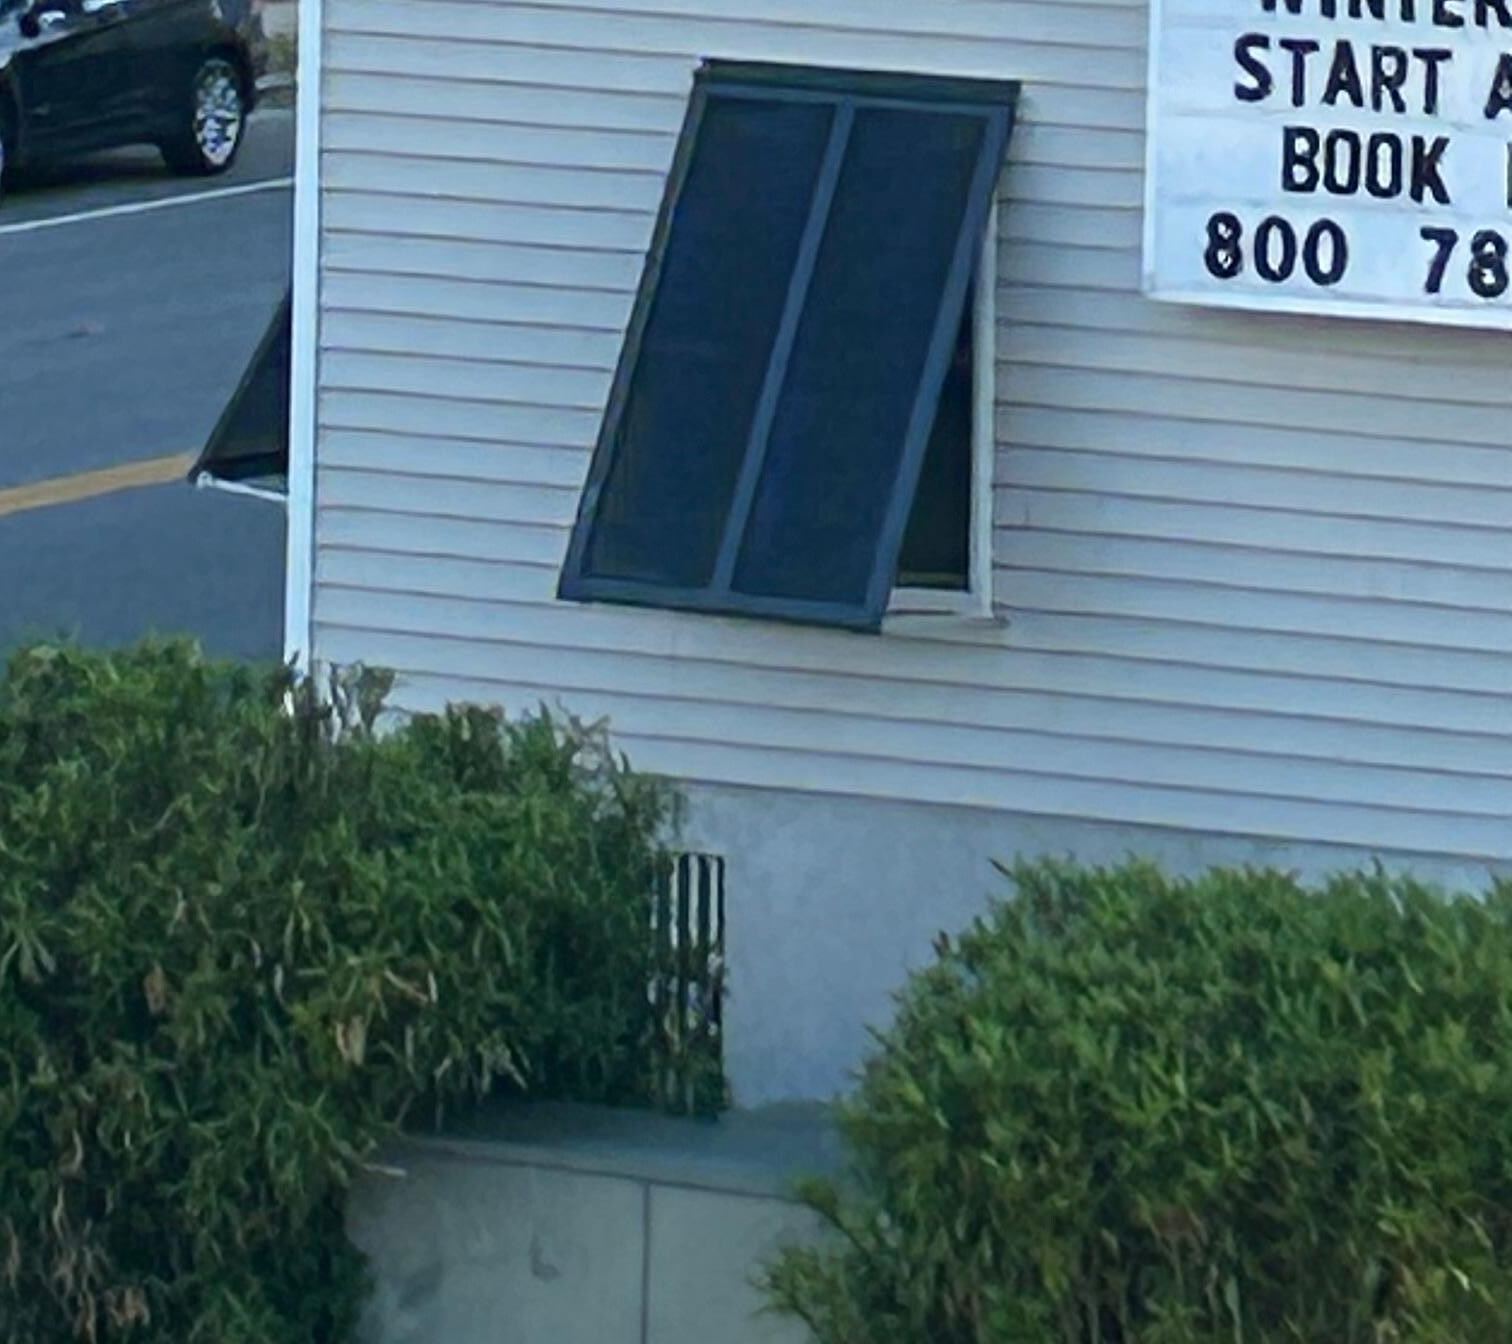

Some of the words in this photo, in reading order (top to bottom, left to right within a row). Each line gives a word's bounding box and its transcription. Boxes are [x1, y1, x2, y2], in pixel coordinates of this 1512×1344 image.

[1234, 32, 1453, 115] START
[1281, 125, 1451, 205] BOOK
[1203, 211, 1348, 286] 800
[1419, 226, 1509, 299] 78
